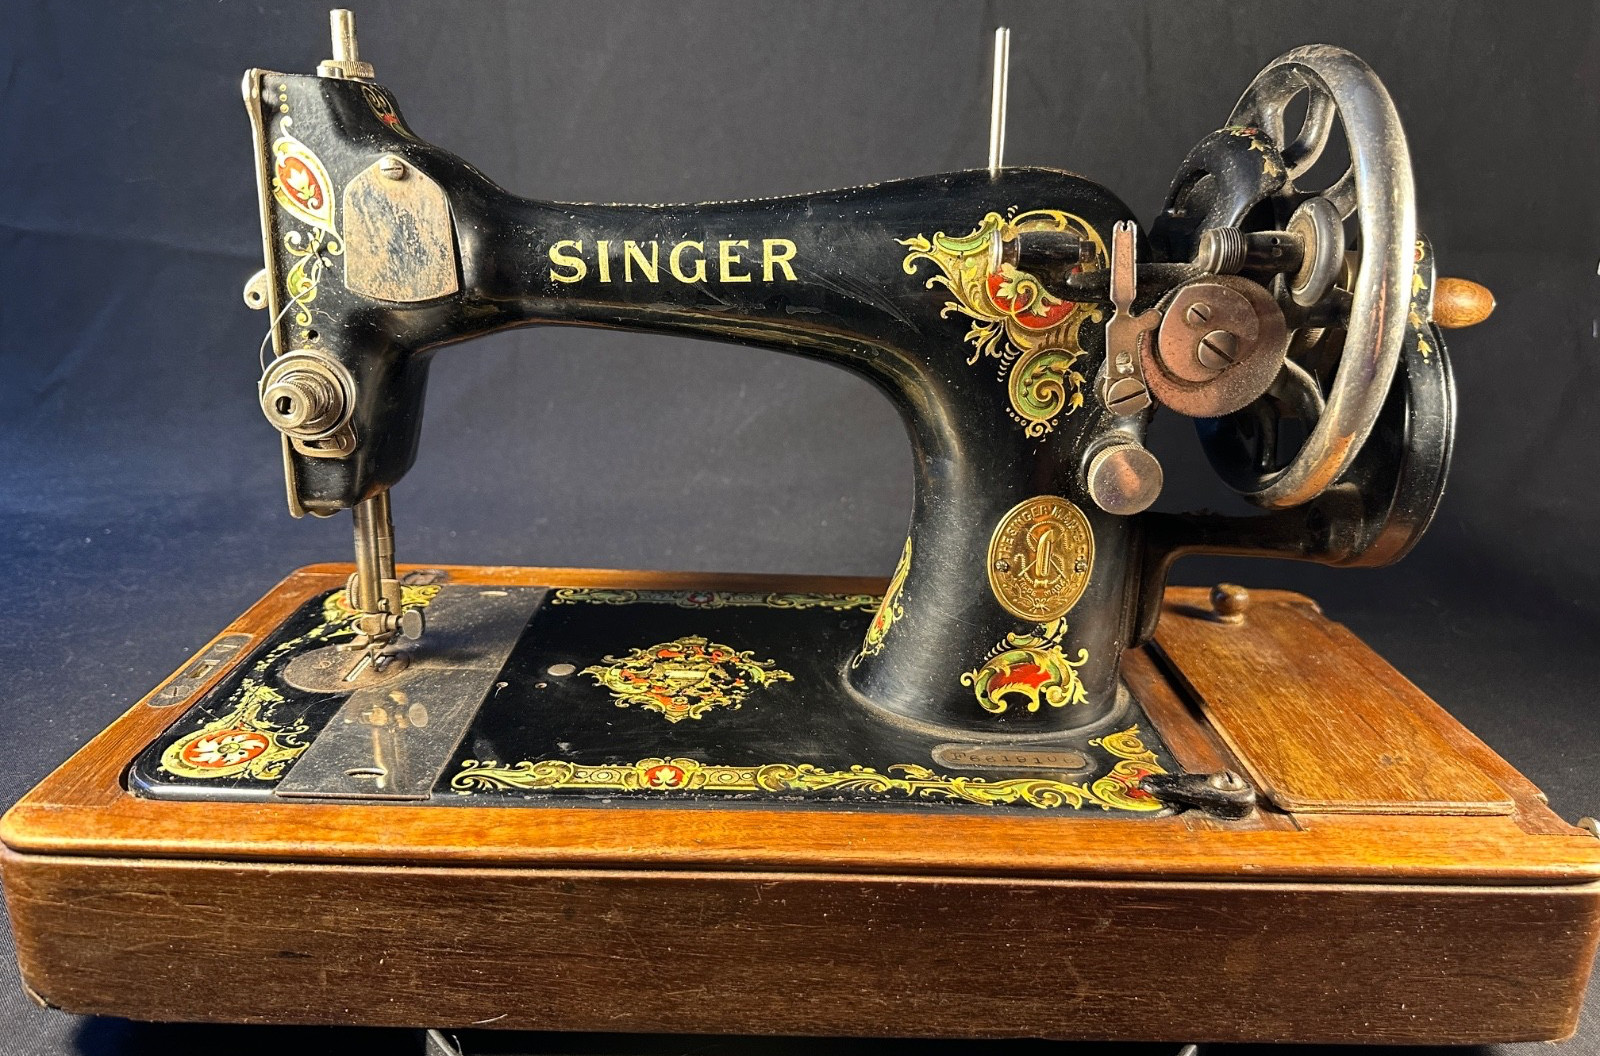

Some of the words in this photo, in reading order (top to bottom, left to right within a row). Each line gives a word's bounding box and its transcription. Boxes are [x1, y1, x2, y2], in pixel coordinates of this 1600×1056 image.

[548, 239, 798, 284] SINGER
[999, 535, 1015, 559] THE
[1007, 505, 1049, 536] SINGER
